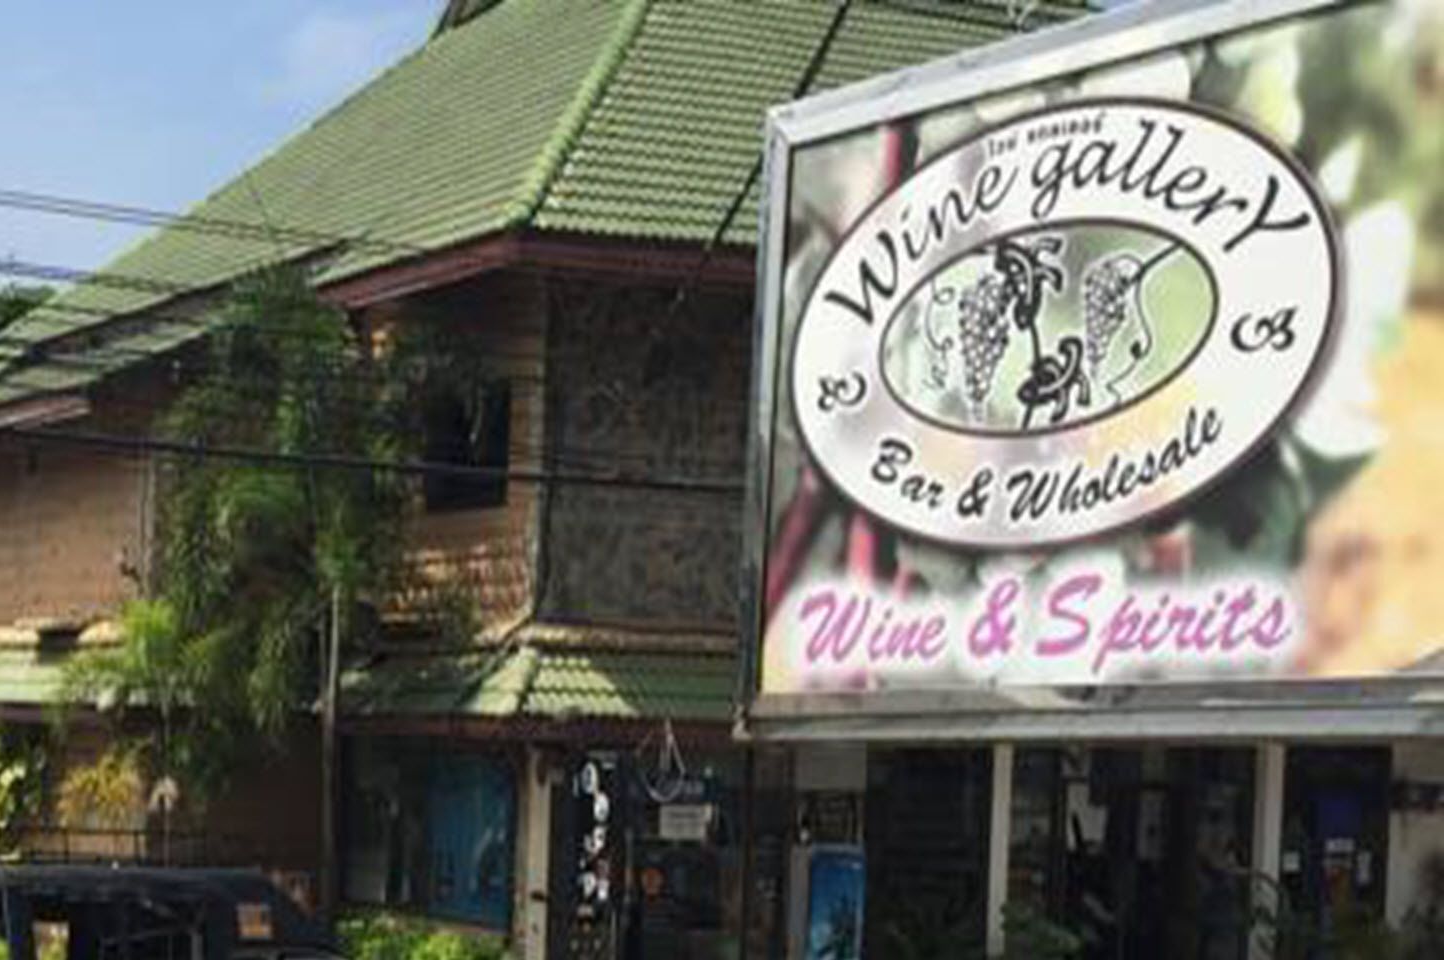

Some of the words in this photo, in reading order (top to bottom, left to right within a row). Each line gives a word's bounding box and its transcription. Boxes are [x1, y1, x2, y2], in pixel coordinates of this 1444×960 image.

[826, 163, 1017, 324] Wine
[871, 438, 945, 507] Bar
[958, 468, 994, 517] &
[1006, 406, 1222, 521] Wholesale
[799, 590, 946, 662] Wine
[967, 578, 1020, 659] &
[1035, 574, 1291, 674] Spirits
